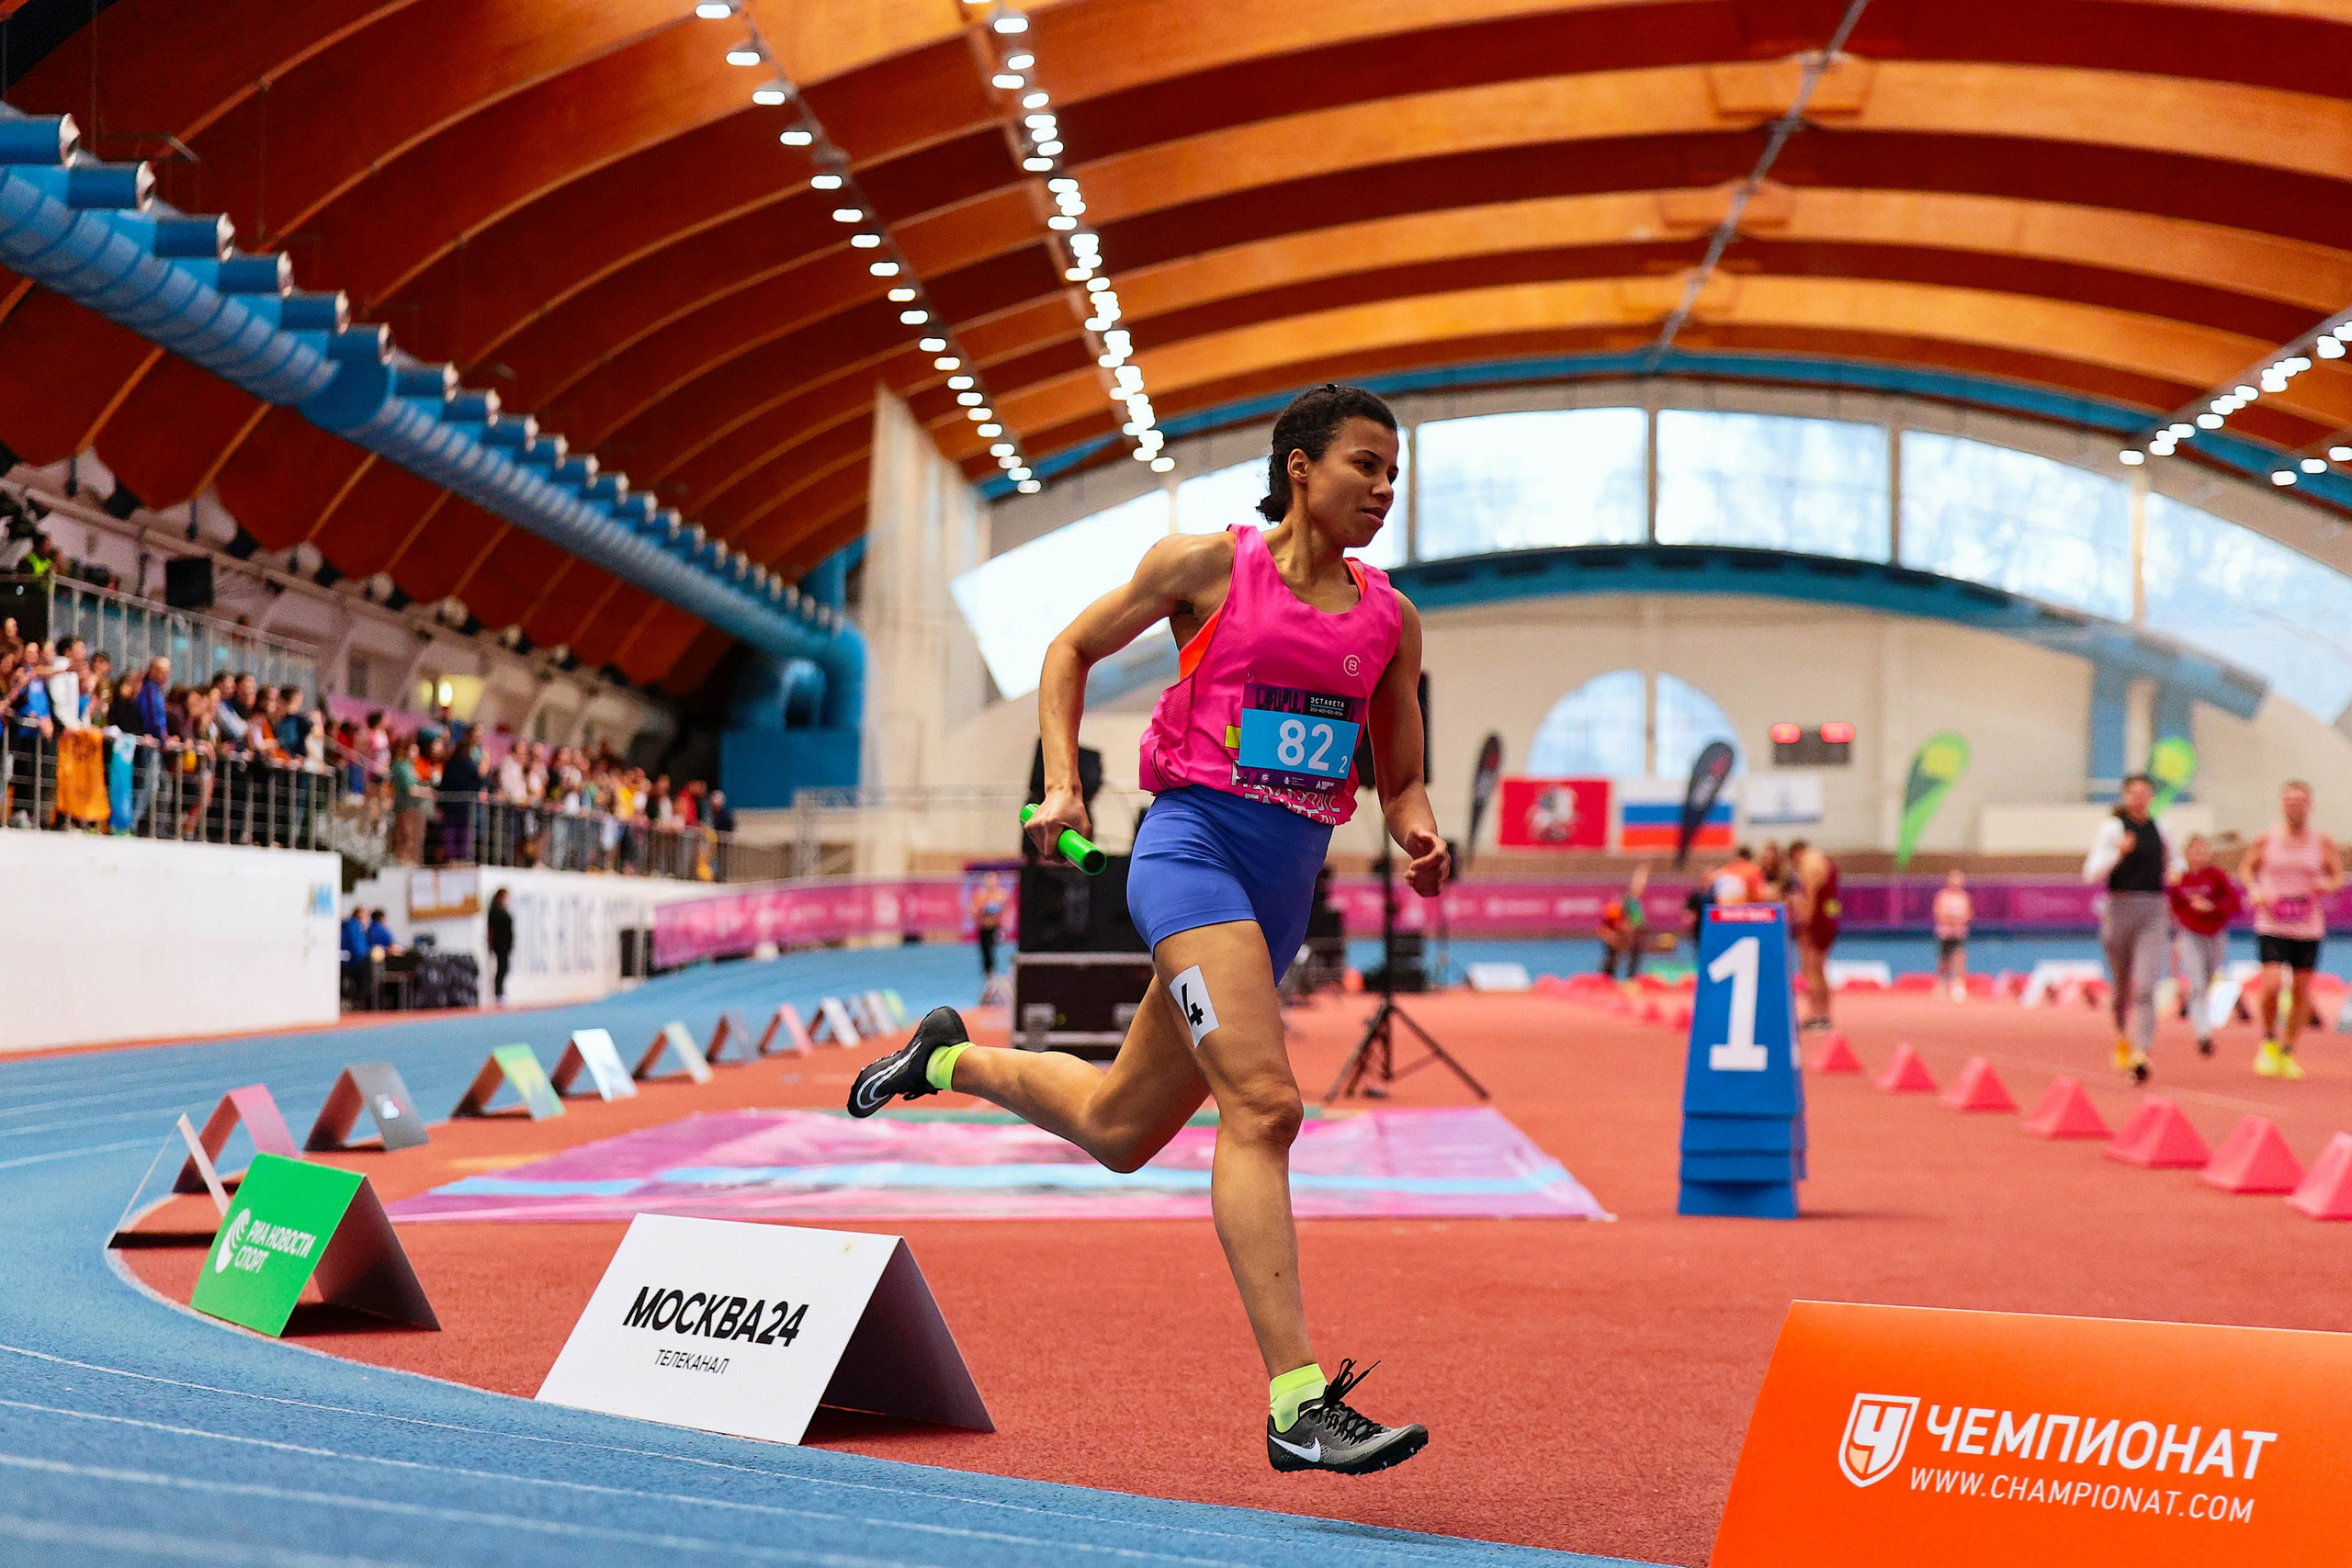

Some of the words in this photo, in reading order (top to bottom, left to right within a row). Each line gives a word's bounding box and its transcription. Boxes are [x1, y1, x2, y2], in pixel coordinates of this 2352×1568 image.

[1310, 696, 1345, 708] ЭСТАФЕТА
[1277, 719, 1334, 772] 82
[1338, 755, 1348, 773] 2
[1182, 982, 1204, 1027] 4
[1707, 936, 1768, 1071] 1
[234, 1245, 269, 1274] СПОРТ
[245, 1219, 271, 1246] РИА
[264, 1224, 317, 1258] НОВОСТИ
[622, 1286, 809, 1348] МОСКВА24
[654, 1348, 730, 1375] ТЕЛЕКАНАЛ
[1926, 1404, 2278, 1481] ЧЕМПИОНАТ
[1910, 1466, 2255, 1524] WWW.CHAMPIONAT.COM
